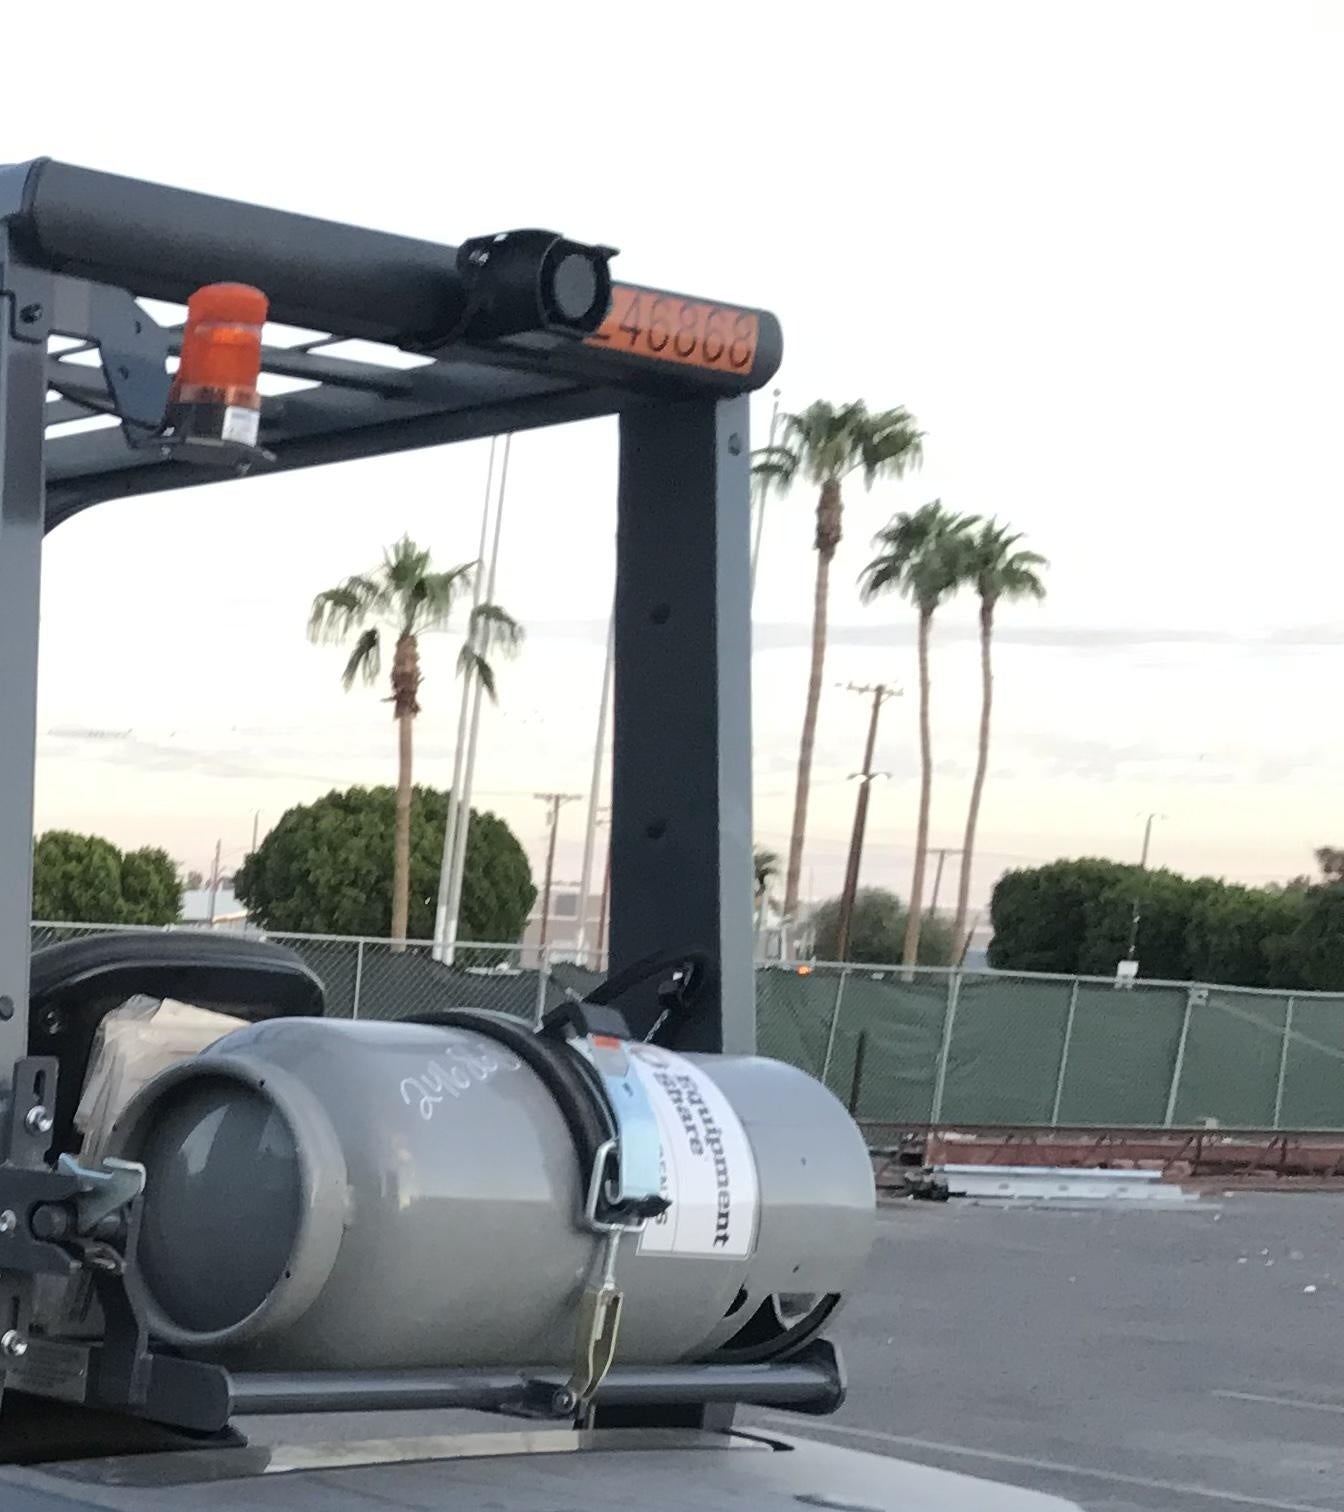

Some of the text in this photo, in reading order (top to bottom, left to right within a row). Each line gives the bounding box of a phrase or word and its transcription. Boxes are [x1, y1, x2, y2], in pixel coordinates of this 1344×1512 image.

[595, 290, 753, 368] 46868
[653, 1071, 704, 1157] Share
[676, 1074, 731, 1248] Equipment
